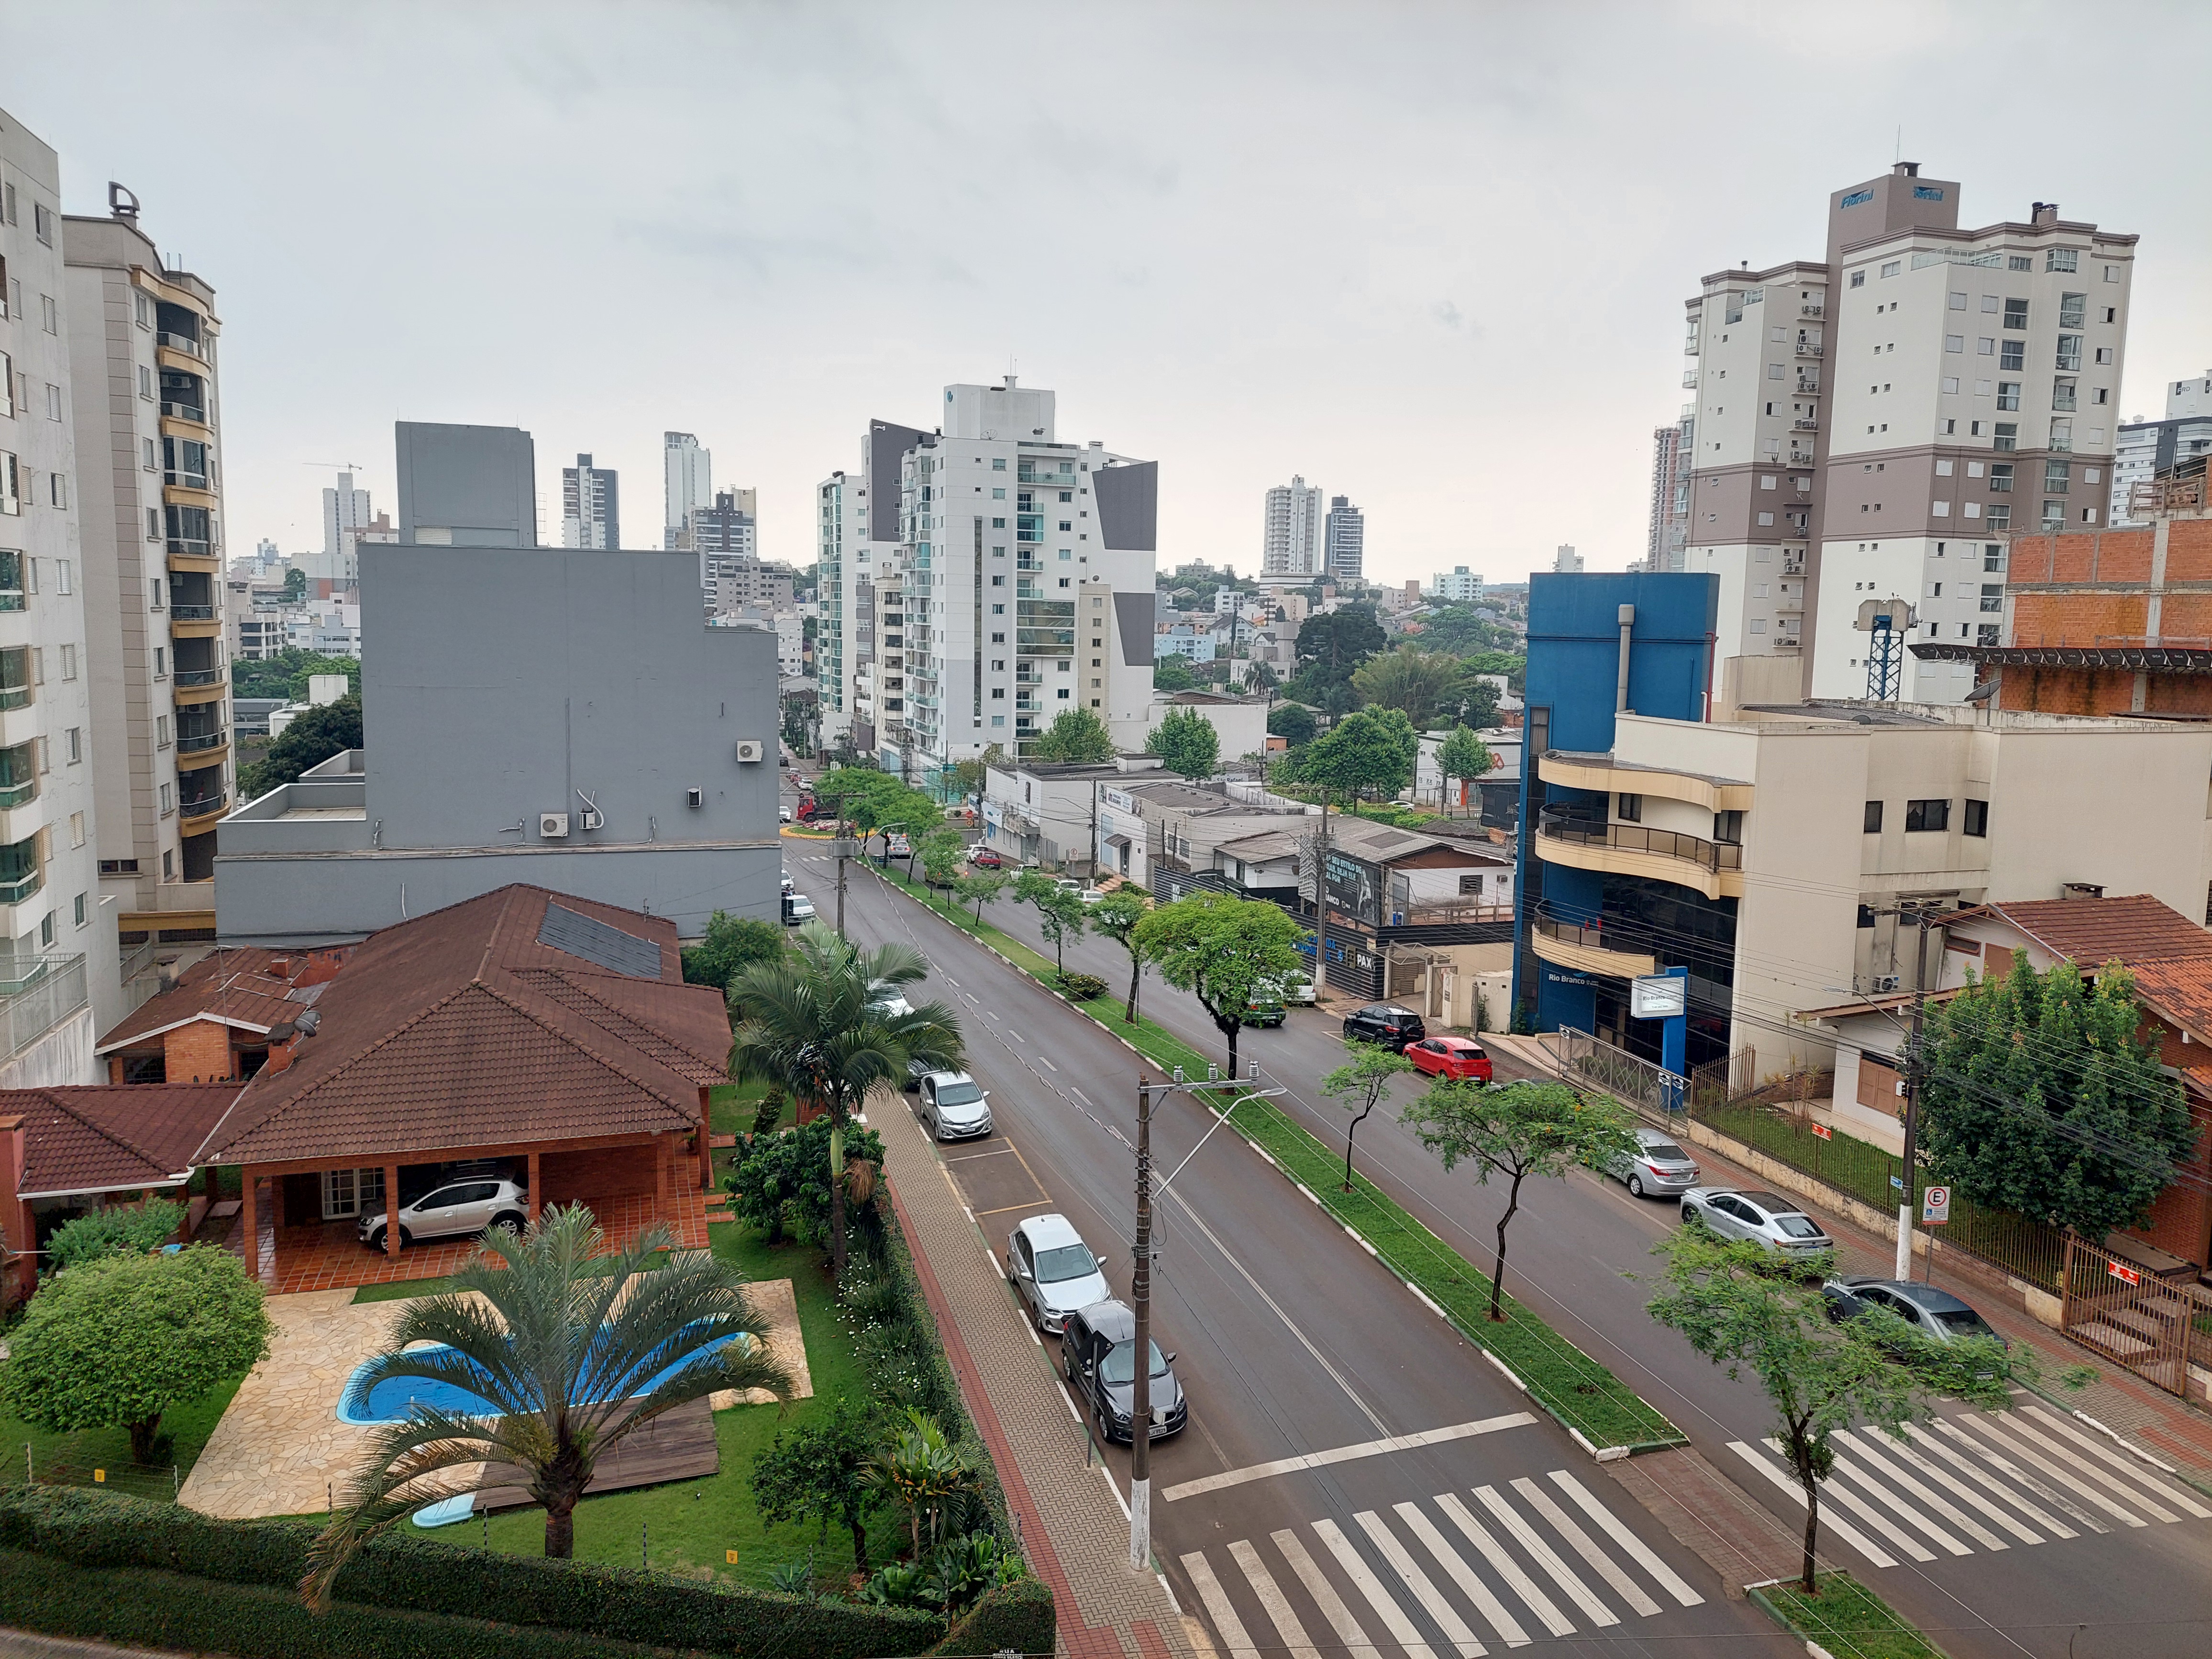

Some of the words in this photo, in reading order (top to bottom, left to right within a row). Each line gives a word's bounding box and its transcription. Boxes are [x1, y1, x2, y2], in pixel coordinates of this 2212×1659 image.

[1840, 187, 1874, 209] Fiorini
[1331, 855, 1340, 866] SEU
[1340, 860, 1355, 871] ESTILO
[1355, 864, 1362, 874] DE
[1337, 867, 1348, 878] SEJA
[1332, 874, 1341, 884] FOR
[1357, 953, 1372, 970] PAX
[1561, 975, 1585, 984] Branco
[1933, 1192, 1941, 1203] E
